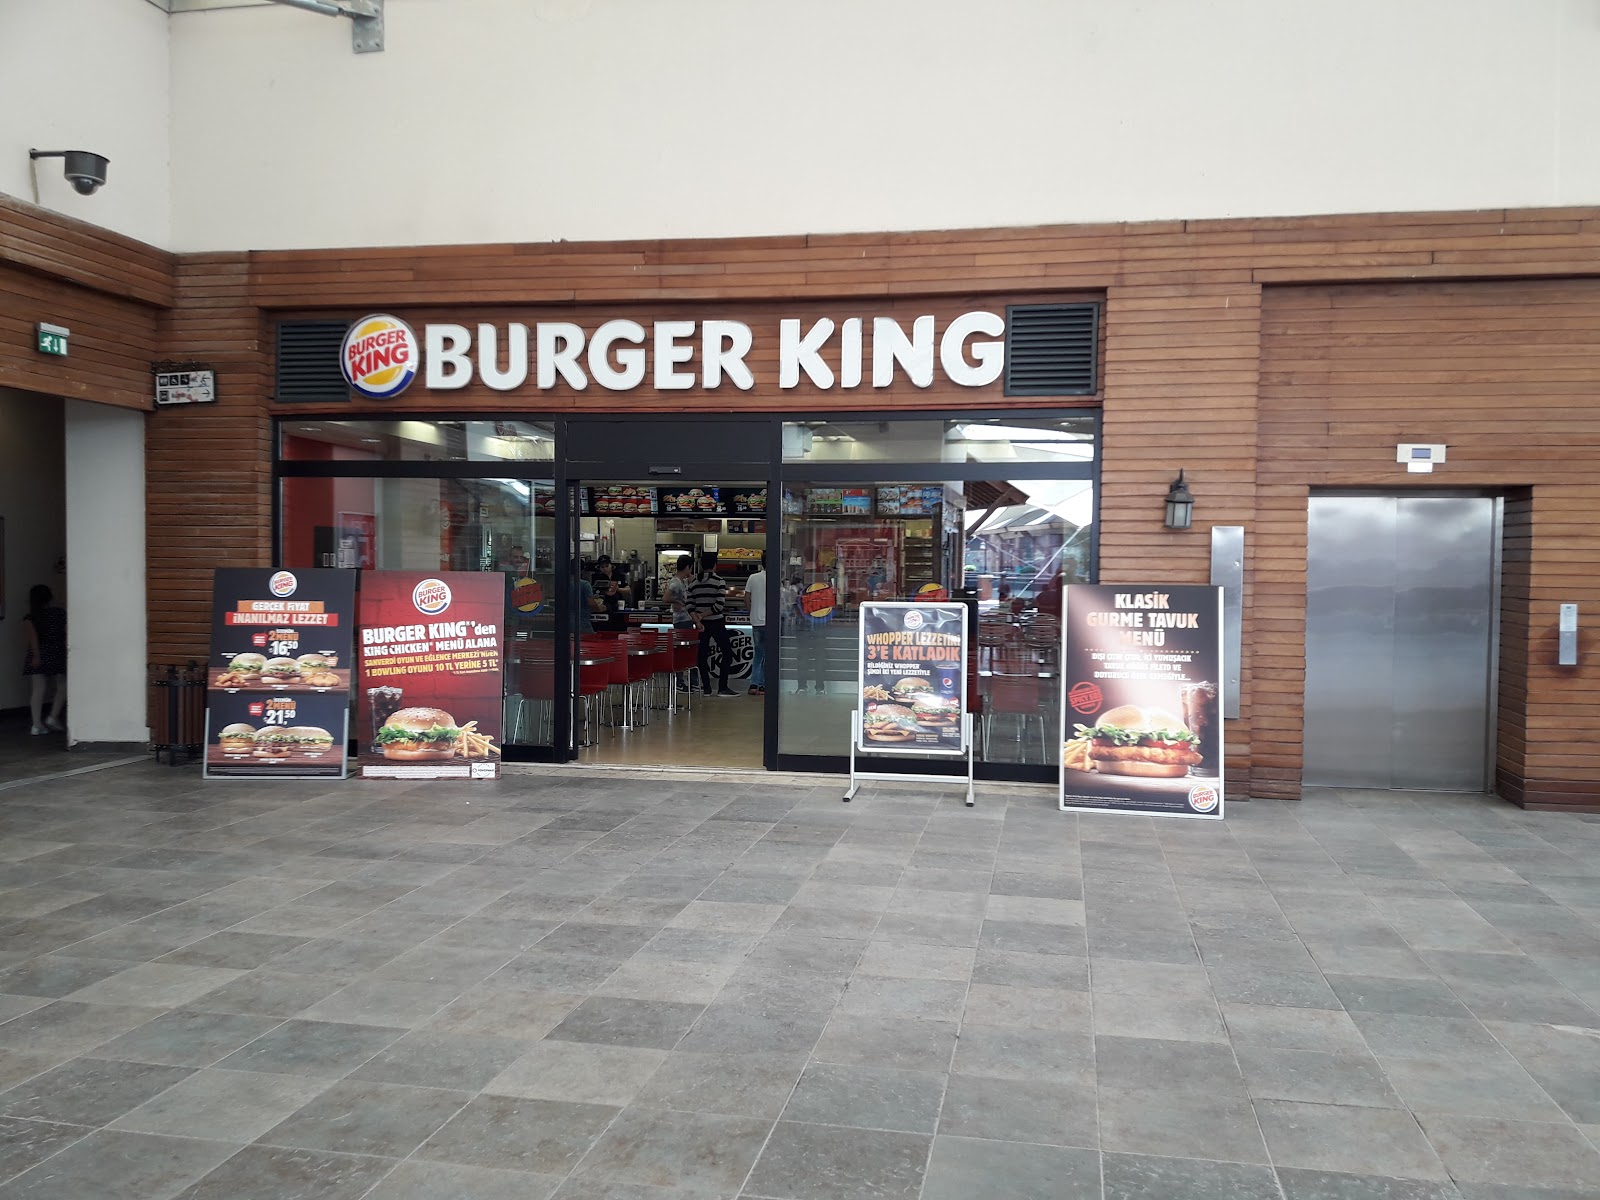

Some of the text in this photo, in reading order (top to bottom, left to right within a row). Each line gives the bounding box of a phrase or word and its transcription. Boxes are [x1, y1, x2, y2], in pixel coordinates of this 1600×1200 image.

[348, 329, 407, 362] BURGER
[425, 311, 1006, 390] BURGER KING
[350, 343, 410, 382] KING
[418, 586, 446, 598] BURGER
[419, 592, 447, 606] KING
[252, 602, 310, 612] GERÇEK FİYAT
[1114, 591, 1169, 610] KLASİK
[292, 614, 329, 624] LEZZET
[1086, 612, 1199, 628] GURME TAVUK
[268, 630, 276, 641] 2
[362, 624, 426, 645] BURGER
[866, 631, 914, 645] WHOPPER
[1119, 629, 1165, 647] MENÜ
[363, 645, 388, 656] KING
[435, 638, 464, 651] MENÜ
[465, 637, 497, 649] ALANA
[867, 645, 961, 661] 3'E KATLADIK
[396, 655, 415, 664] OYUN
[415, 655, 424, 663] VE
[424, 652, 452, 663] EĞLENCE
[1153, 654, 1192, 663] YUMUŞACIK
[364, 669, 371, 677] 1
[371, 666, 407, 677] BOWLING
[407, 664, 433, 674] OYUNU
[435, 663, 444, 671] 10
[445, 662, 454, 671] TL
[454, 659, 481, 670] YERİNE
[482, 660, 488, 668] 5
[266, 699, 273, 710] 2
[1192, 789, 1214, 800] BURGER
[1193, 795, 1215, 805] KING
